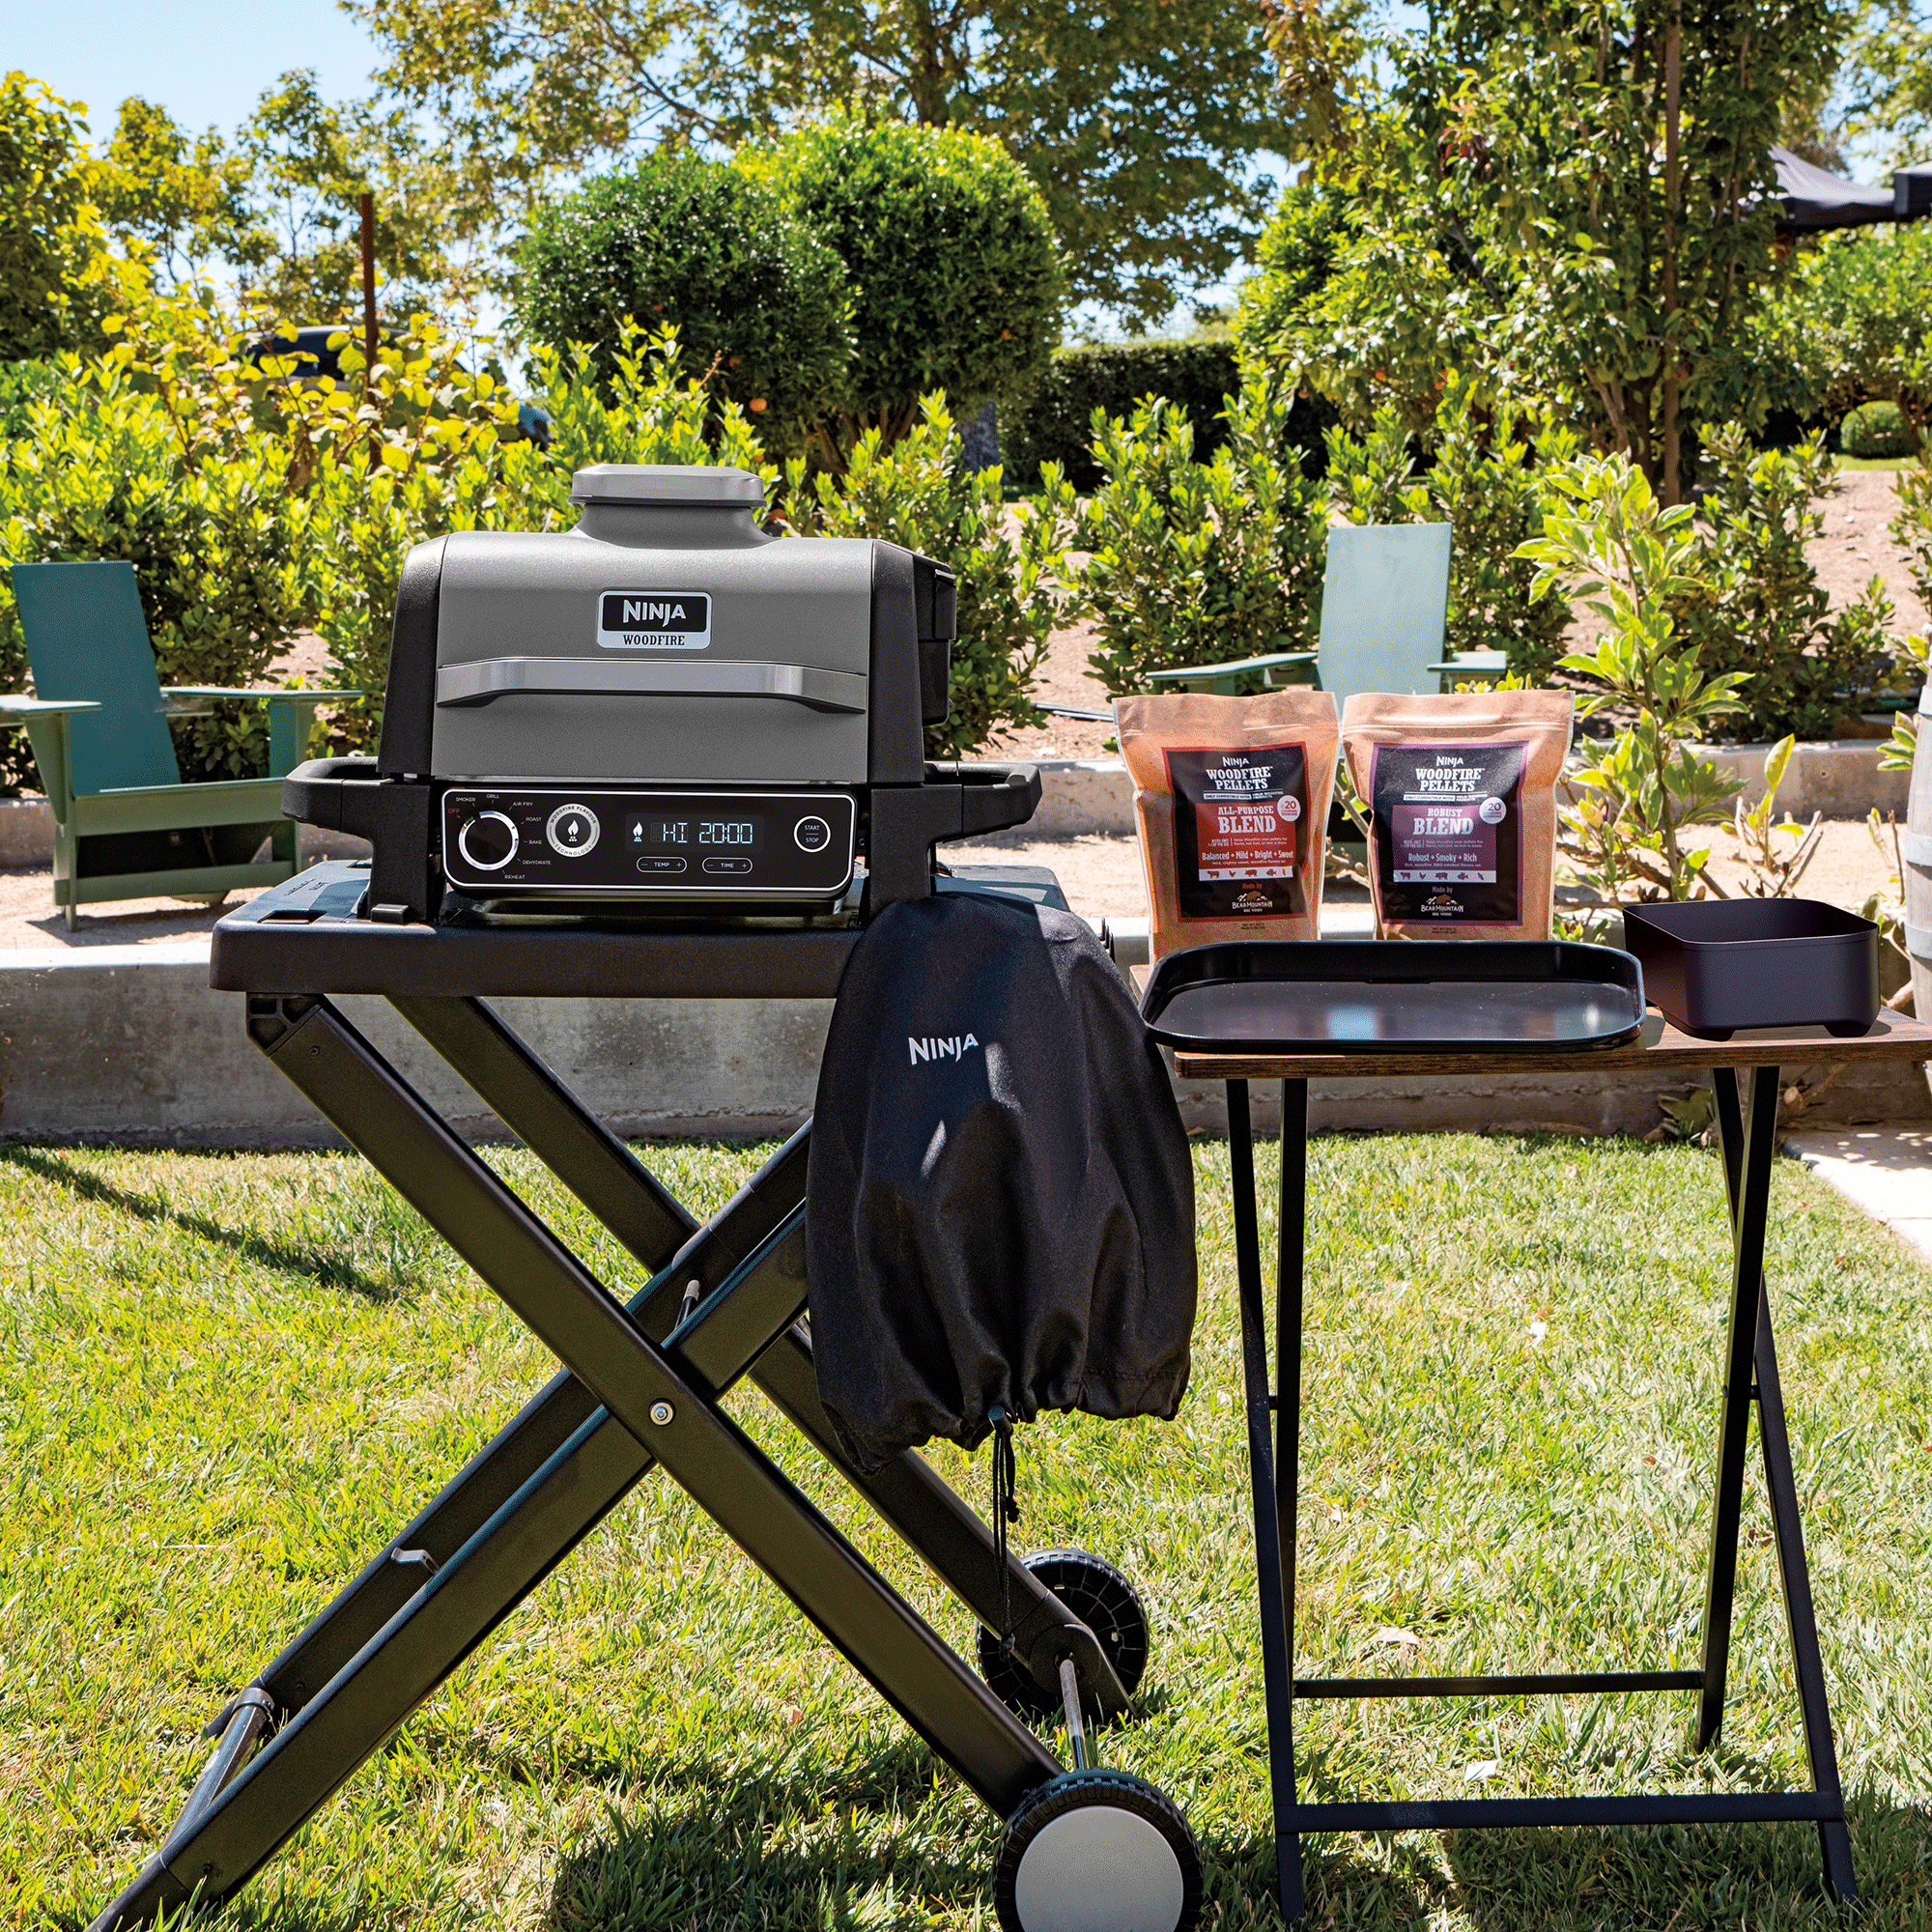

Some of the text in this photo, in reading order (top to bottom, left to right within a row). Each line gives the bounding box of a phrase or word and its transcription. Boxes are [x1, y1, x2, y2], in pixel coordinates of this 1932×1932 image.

[622, 599, 687, 628] NINJA
[623, 635, 685, 646] WOODFIRE
[1222, 755, 1250, 768] NINJA
[1435, 755, 1463, 768] NINJA
[1206, 766, 1271, 781] WOODFIRE
[1415, 768, 1482, 781] WOODFIRE
[1214, 778, 1268, 791] PELLETS
[1419, 780, 1476, 792] PELLETS
[1217, 805, 1274, 815] ALL-PURPOSE
[1284, 801, 1296, 810] 20
[1487, 802, 1502, 811] 20
[551, 806, 597, 824] WOODFIRE FLAVOUR
[1427, 808, 1463, 817] ROBUST
[1217, 815, 1276, 834] BLEND
[1412, 817, 1474, 835] BLEND
[554, 843, 592, 856] TECHNOLOGY
[1202, 851, 1230, 861] Balanced
[1254, 850, 1272, 860] Bright
[1407, 852, 1477, 863] Robust Smoky Rich
[908, 1033, 979, 1065] NINJA
